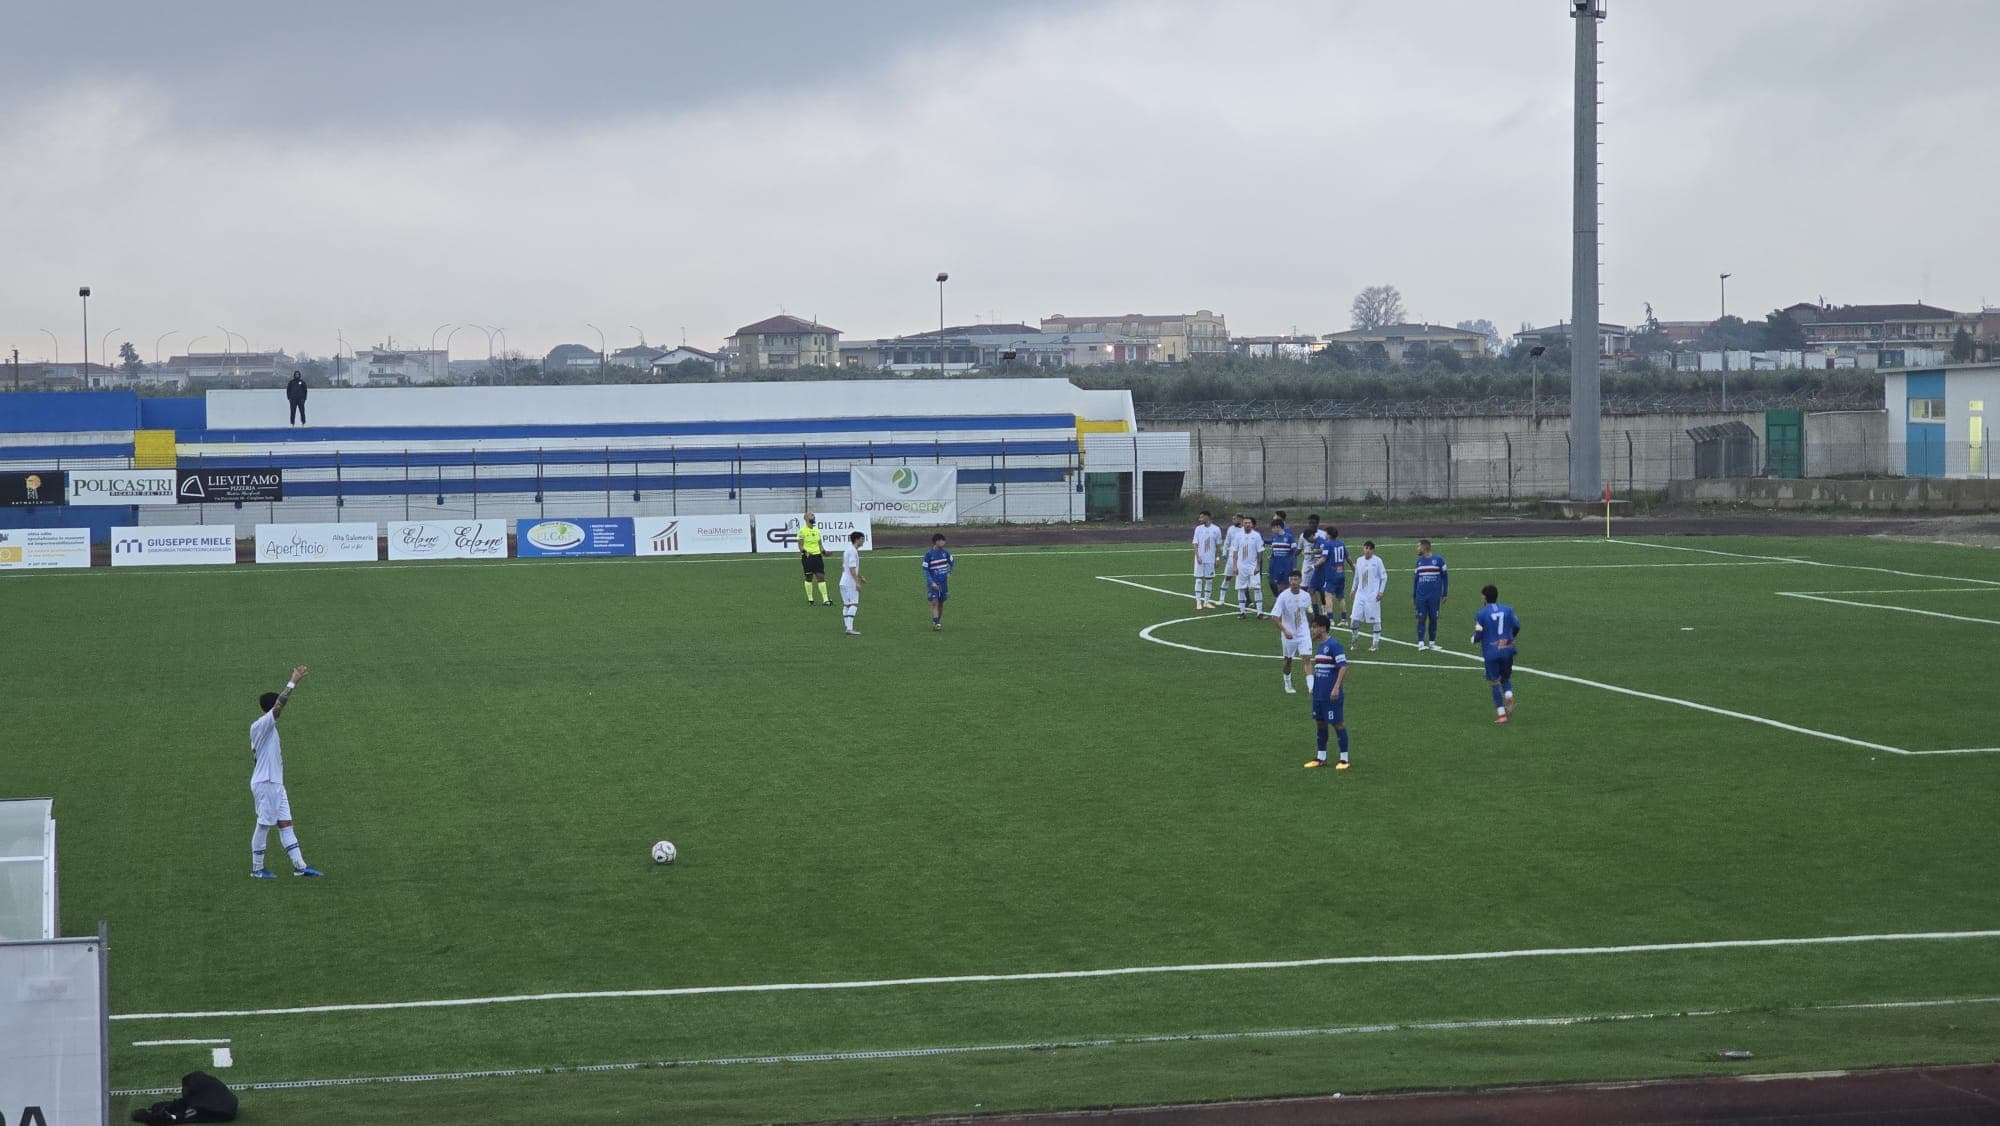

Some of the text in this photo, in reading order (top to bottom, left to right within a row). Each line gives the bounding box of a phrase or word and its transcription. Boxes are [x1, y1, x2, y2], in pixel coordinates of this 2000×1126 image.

[208, 474, 279, 486] LIEVIT'AMO
[72, 479, 174, 497] POLICASTRI
[812, 521, 855, 530] DILIZIA
[147, 537, 232, 547] GIUSEPPE MIELE
[1333, 546, 1344, 563] 10
[1491, 611, 1505, 635] 7
[1328, 710, 1334, 720] 8
